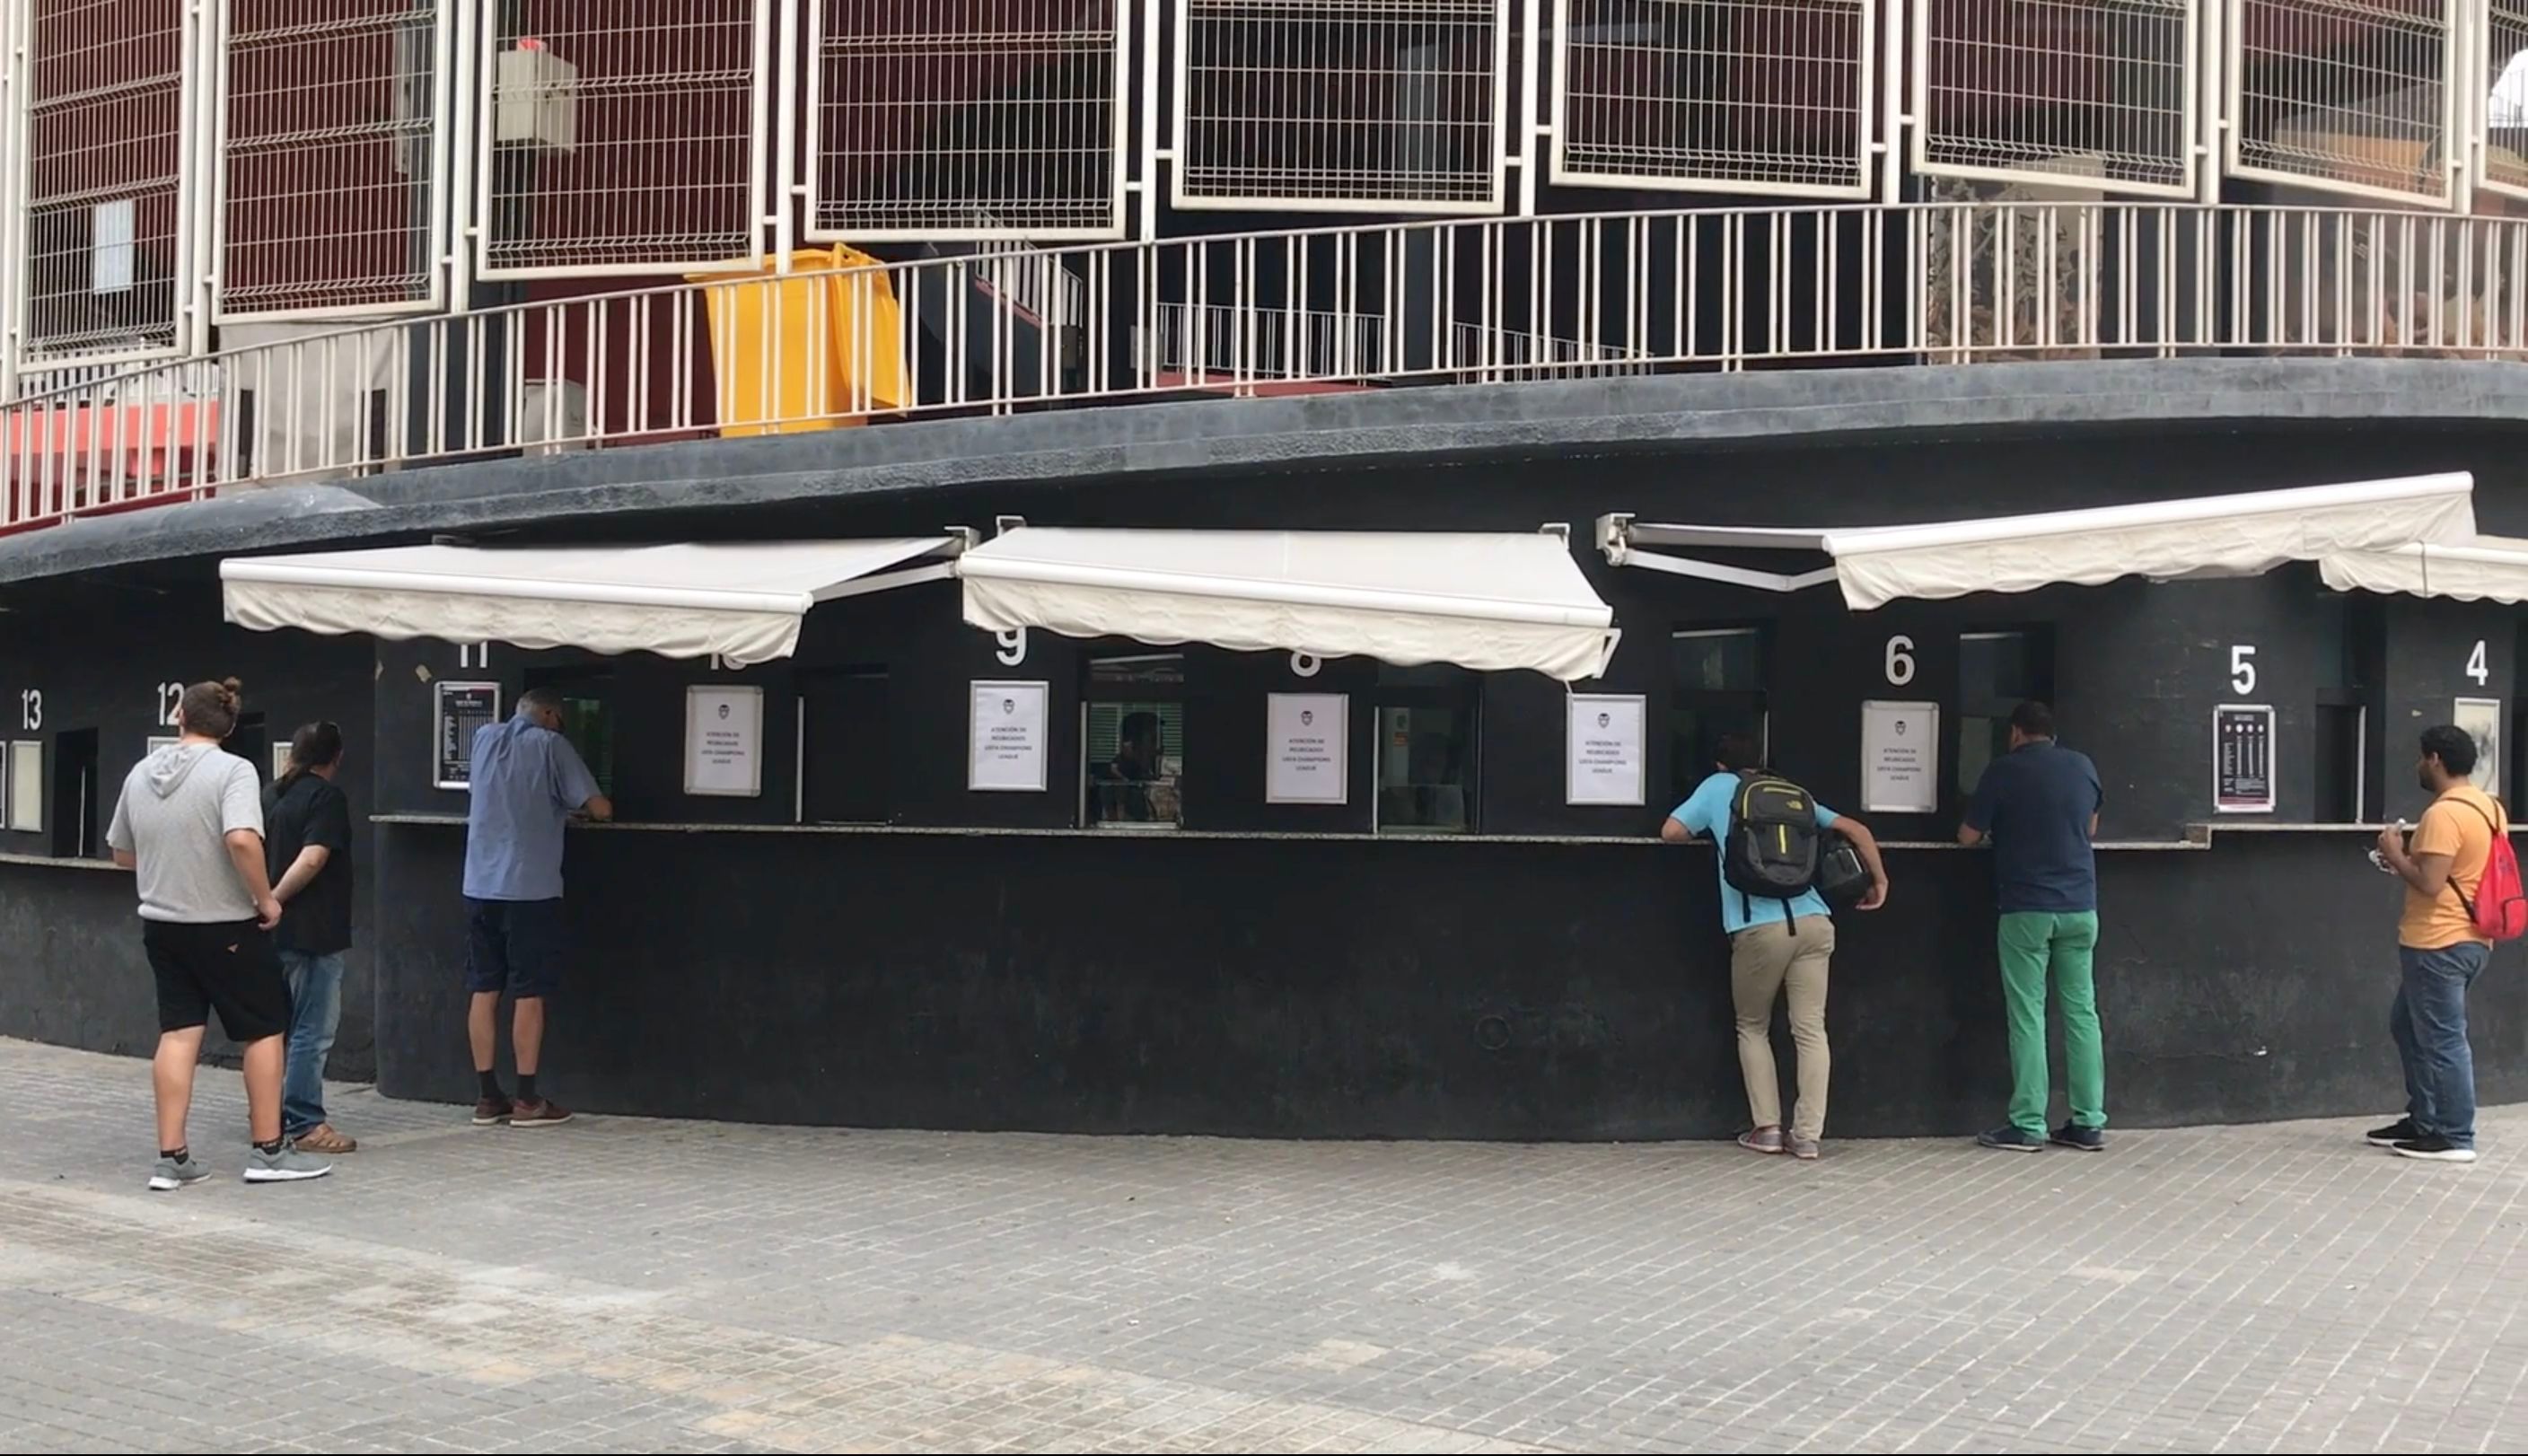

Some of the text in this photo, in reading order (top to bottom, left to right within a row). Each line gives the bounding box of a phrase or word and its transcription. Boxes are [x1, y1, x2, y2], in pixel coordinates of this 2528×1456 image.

[996, 627, 1028, 666] 9
[1593, 628, 1622, 680] 7
[1885, 635, 1916, 686] 6
[2465, 639, 2489, 686] 4
[2230, 645, 2257, 696] 5
[21, 689, 43, 731] 13
[157, 681, 186, 726] 12
